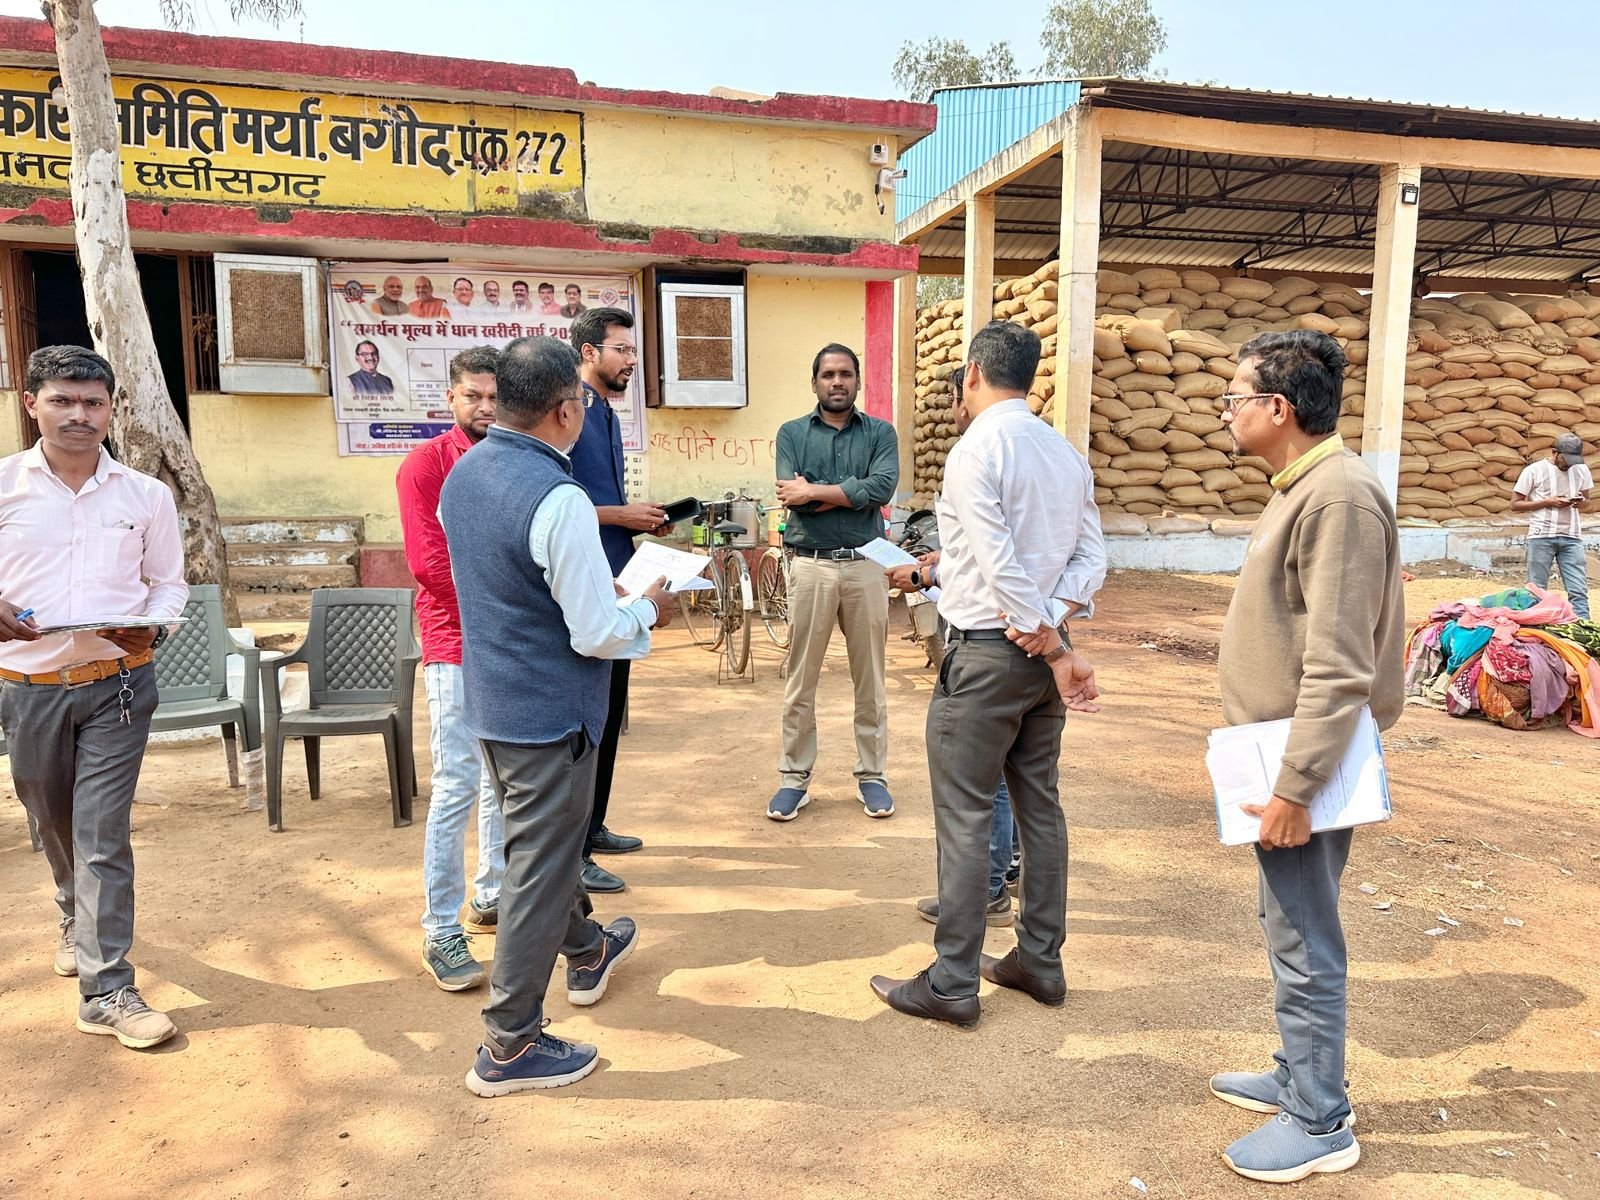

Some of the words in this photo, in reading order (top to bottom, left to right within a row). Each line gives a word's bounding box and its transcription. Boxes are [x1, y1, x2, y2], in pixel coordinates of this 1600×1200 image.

[230, 96, 328, 161] मर्या.
[516, 131, 566, 175] 272
[401, 324, 432, 341] मूल्य
[436, 320, 448, 337] में
[451, 324, 477, 338] धान
[481, 322, 523, 339] खरीदी
[550, 327, 572, 340] 20
[674, 426, 717, 461] पीने
